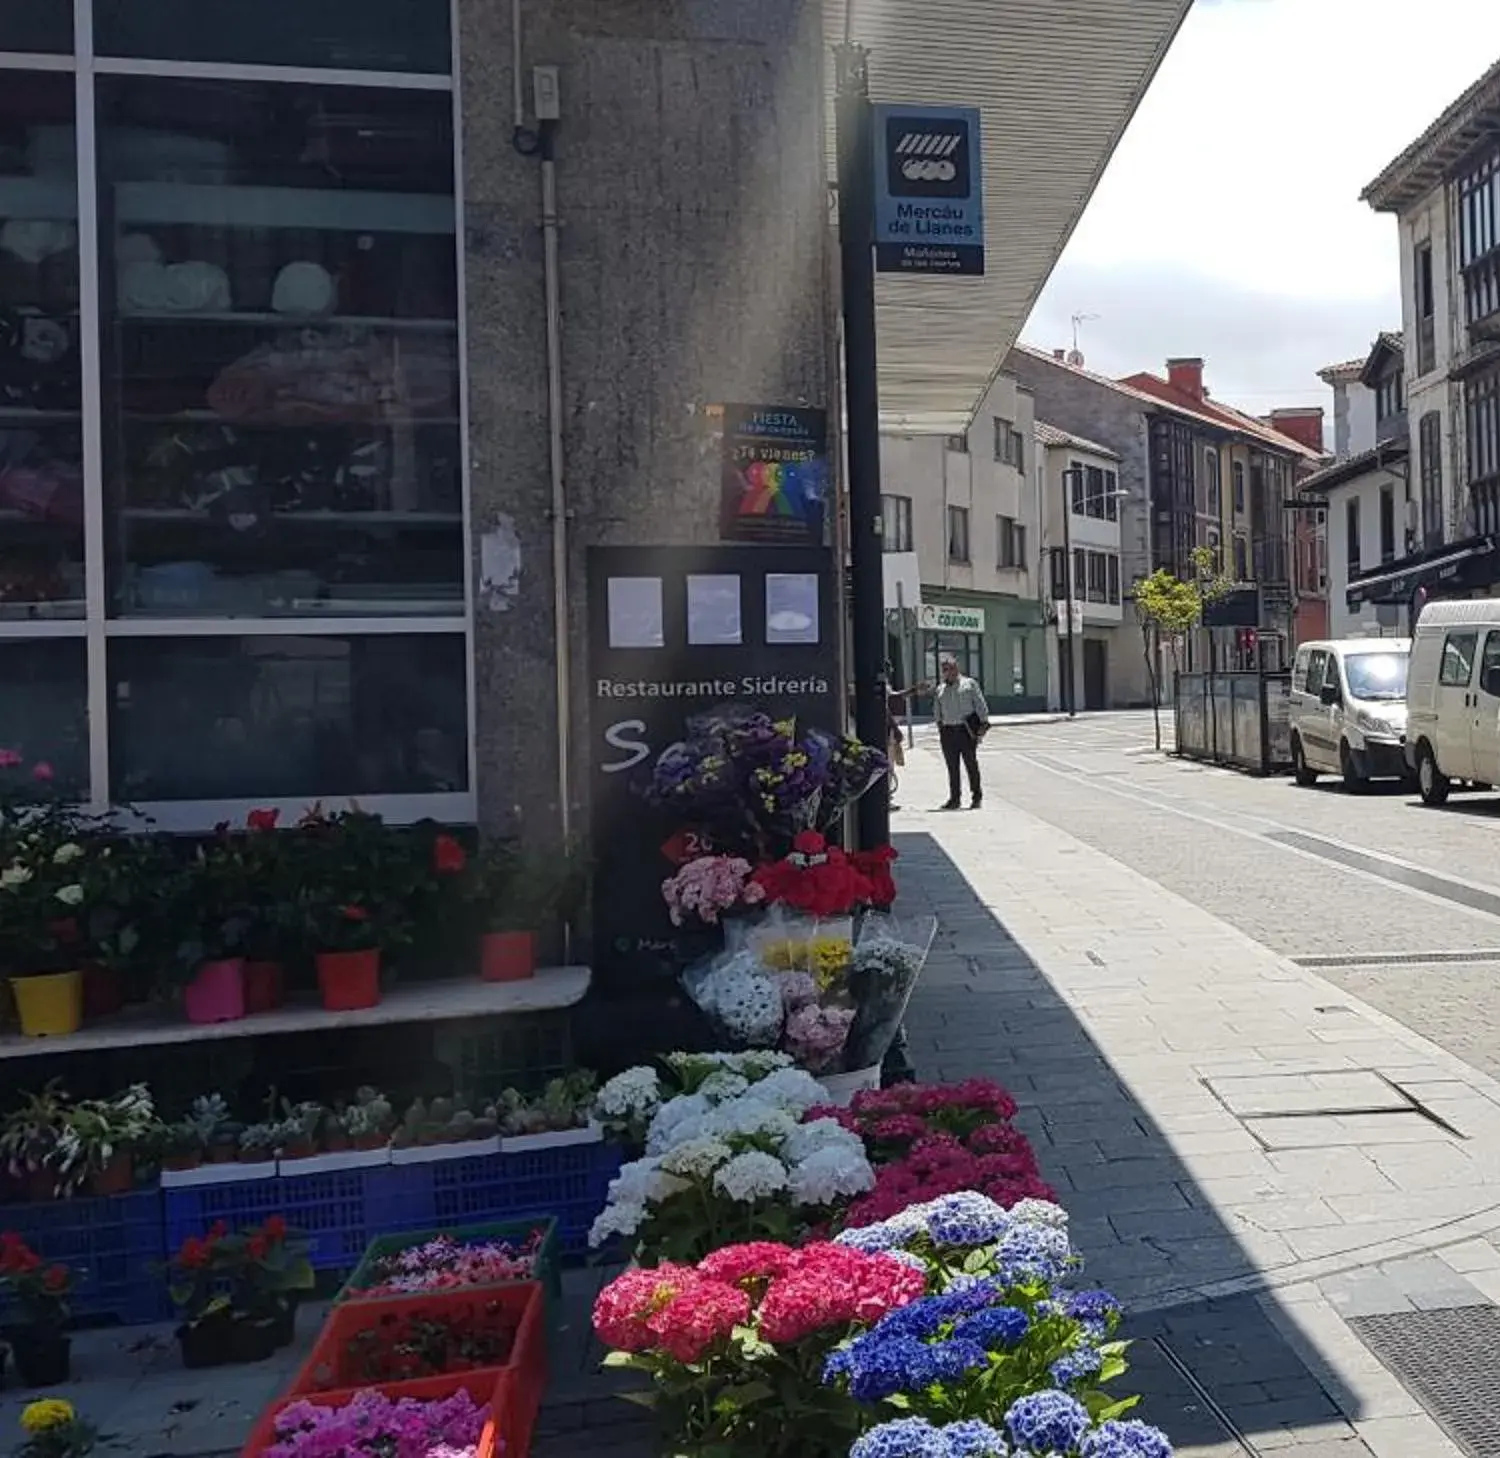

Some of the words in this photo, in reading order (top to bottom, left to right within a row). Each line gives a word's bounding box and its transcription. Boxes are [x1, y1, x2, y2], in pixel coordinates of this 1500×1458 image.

[896, 203, 964, 219] Mercáu
[888, 220, 910, 234] de
[915, 220, 974, 236] Llanes
[596, 678, 737, 698] Restaurante
